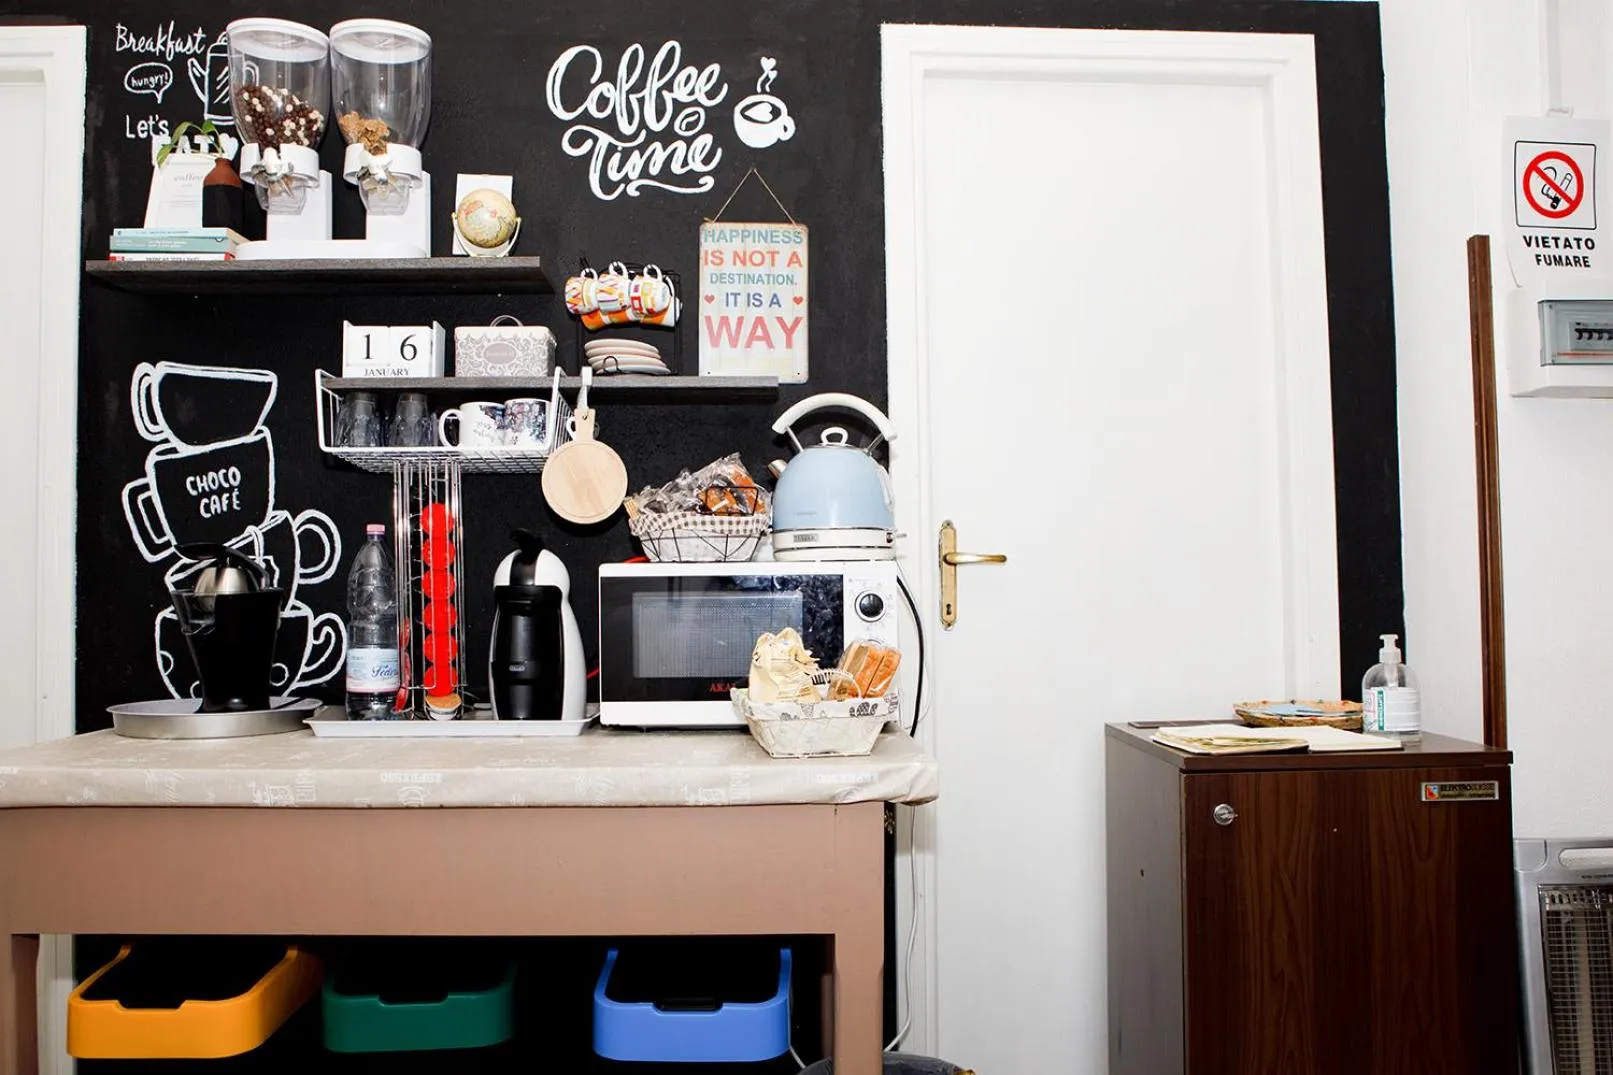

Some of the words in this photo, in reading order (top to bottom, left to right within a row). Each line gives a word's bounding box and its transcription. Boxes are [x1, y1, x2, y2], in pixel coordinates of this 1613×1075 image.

[116, 20, 206, 61] Breakfast
[546, 40, 729, 136] Coffee
[125, 114, 170, 138] Let's
[561, 124, 722, 200] Time
[703, 229, 804, 245] HAPPINESS
[1522, 235, 1596, 251] VIETATO
[704, 250, 725, 266] IS
[732, 251, 780, 267] NOT
[786, 251, 804, 268] A
[1535, 254, 1592, 268] FUMARE
[709, 272, 798, 286] DESTINATION.
[725, 292, 741, 308] IT
[747, 292, 763, 308] IS
[768, 293, 782, 308] A
[704, 315, 804, 349] WAY
[363, 333, 375, 360] 1
[400, 333, 418, 361] 6
[364, 367, 410, 377] JANUARY
[186, 466, 242, 497] CHOCO
